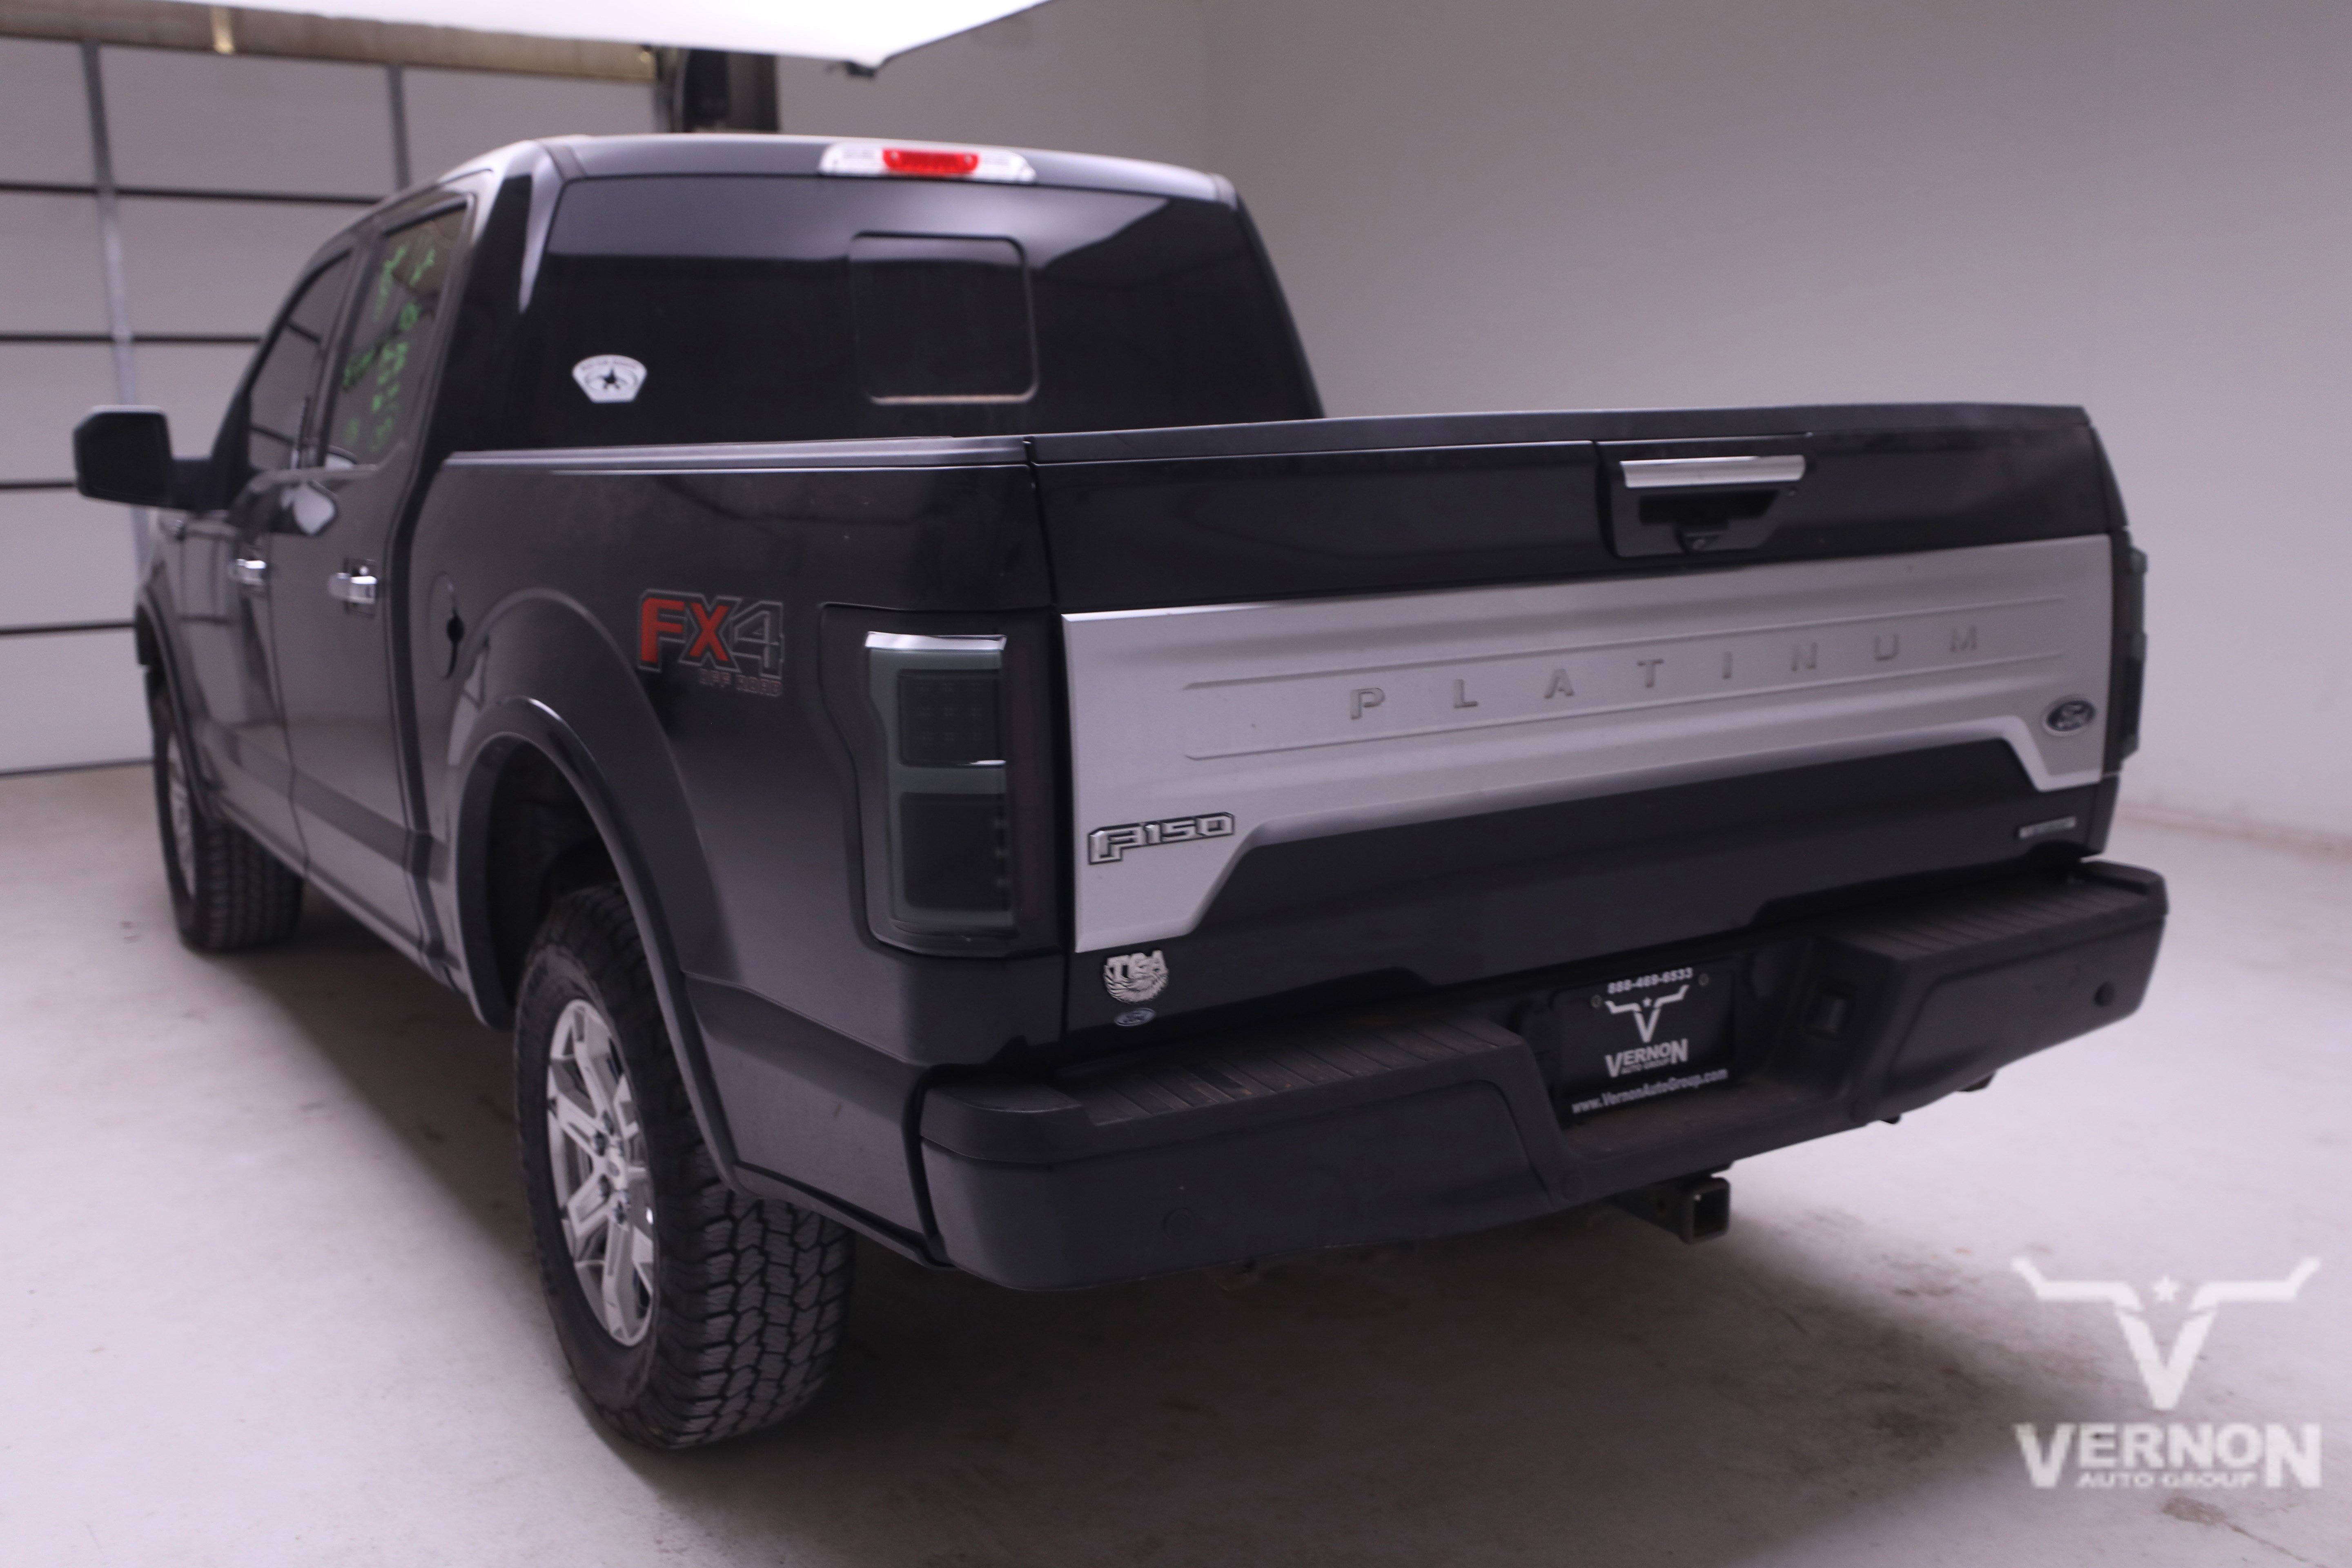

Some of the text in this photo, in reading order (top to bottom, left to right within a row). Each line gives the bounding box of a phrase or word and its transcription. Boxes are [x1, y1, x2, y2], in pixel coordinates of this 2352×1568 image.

[637, 588, 785, 679] FX4
[1349, 625, 1978, 720] PLATINUM
[1604, 1038, 1688, 1078] VERNON
